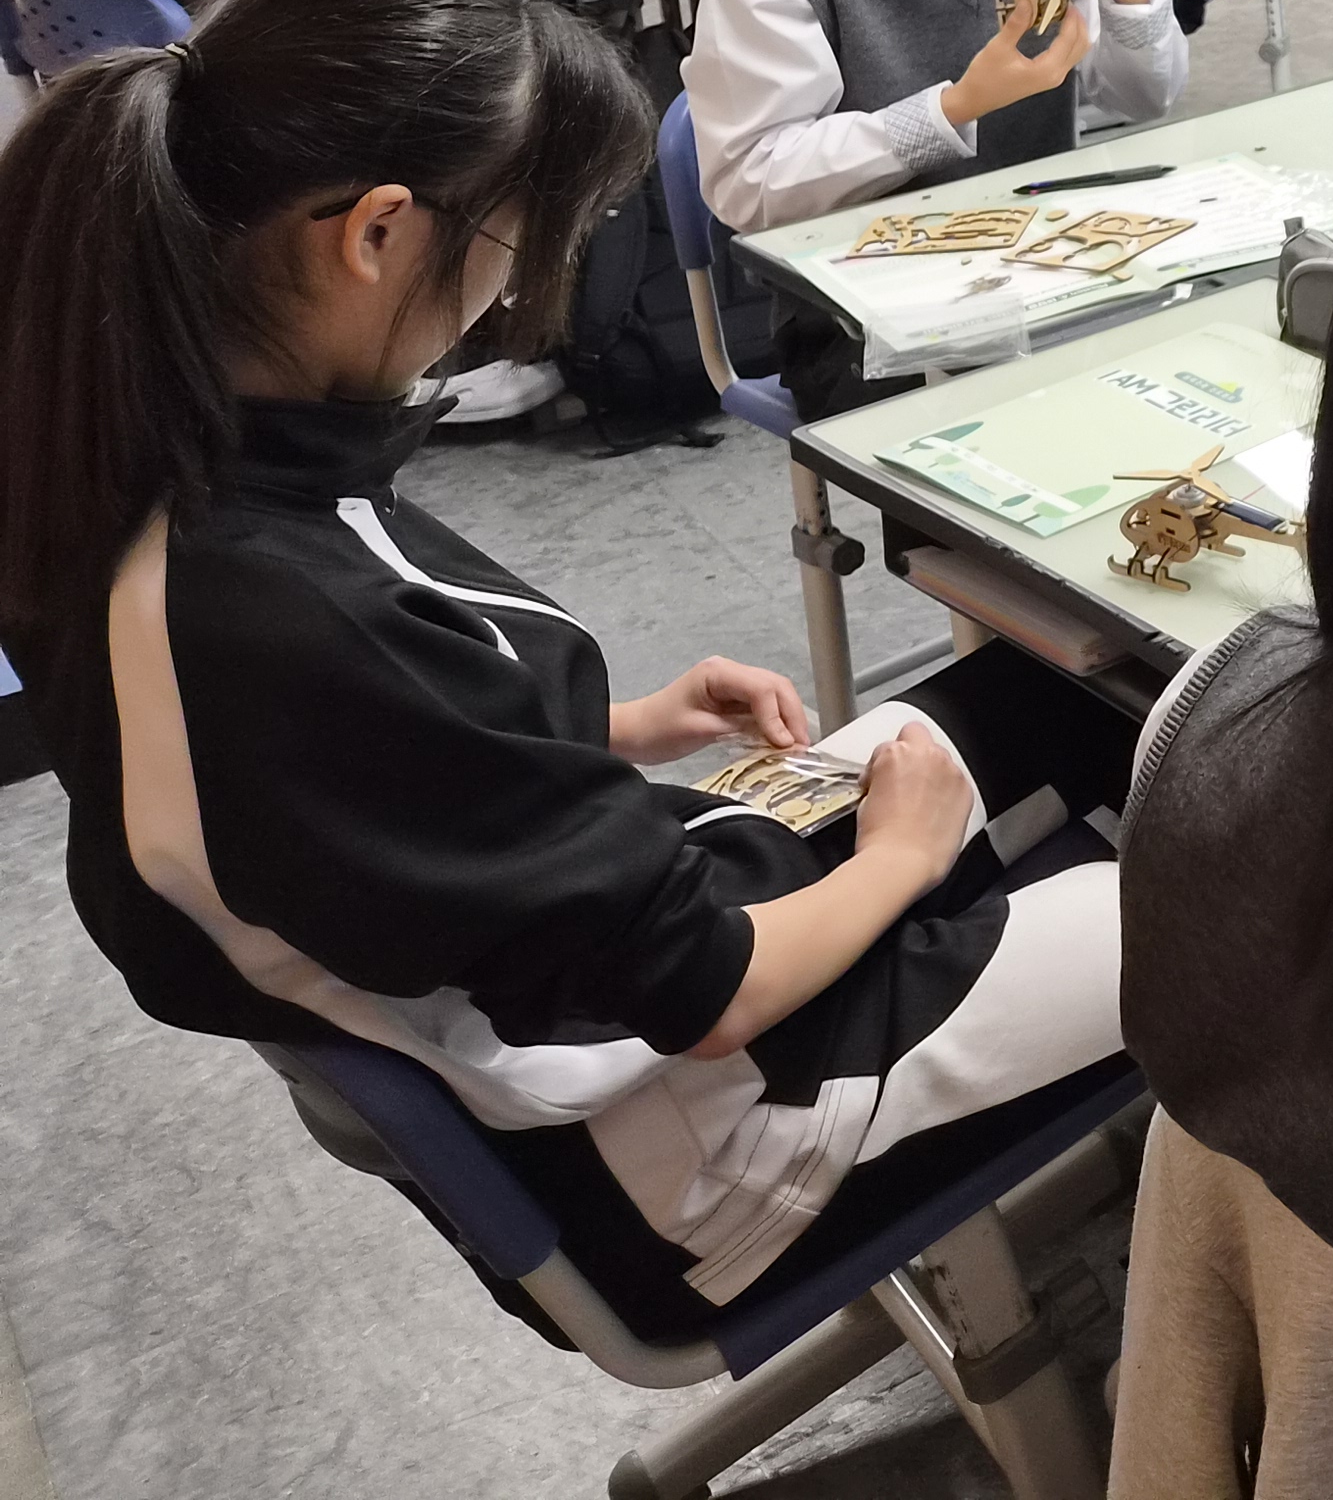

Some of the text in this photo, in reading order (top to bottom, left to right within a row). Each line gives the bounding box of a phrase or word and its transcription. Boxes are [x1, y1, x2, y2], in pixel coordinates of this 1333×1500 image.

[1097, 369, 1122, 380] I
[1106, 373, 1161, 395] AM
[1144, 389, 1253, 438] 그린리더
